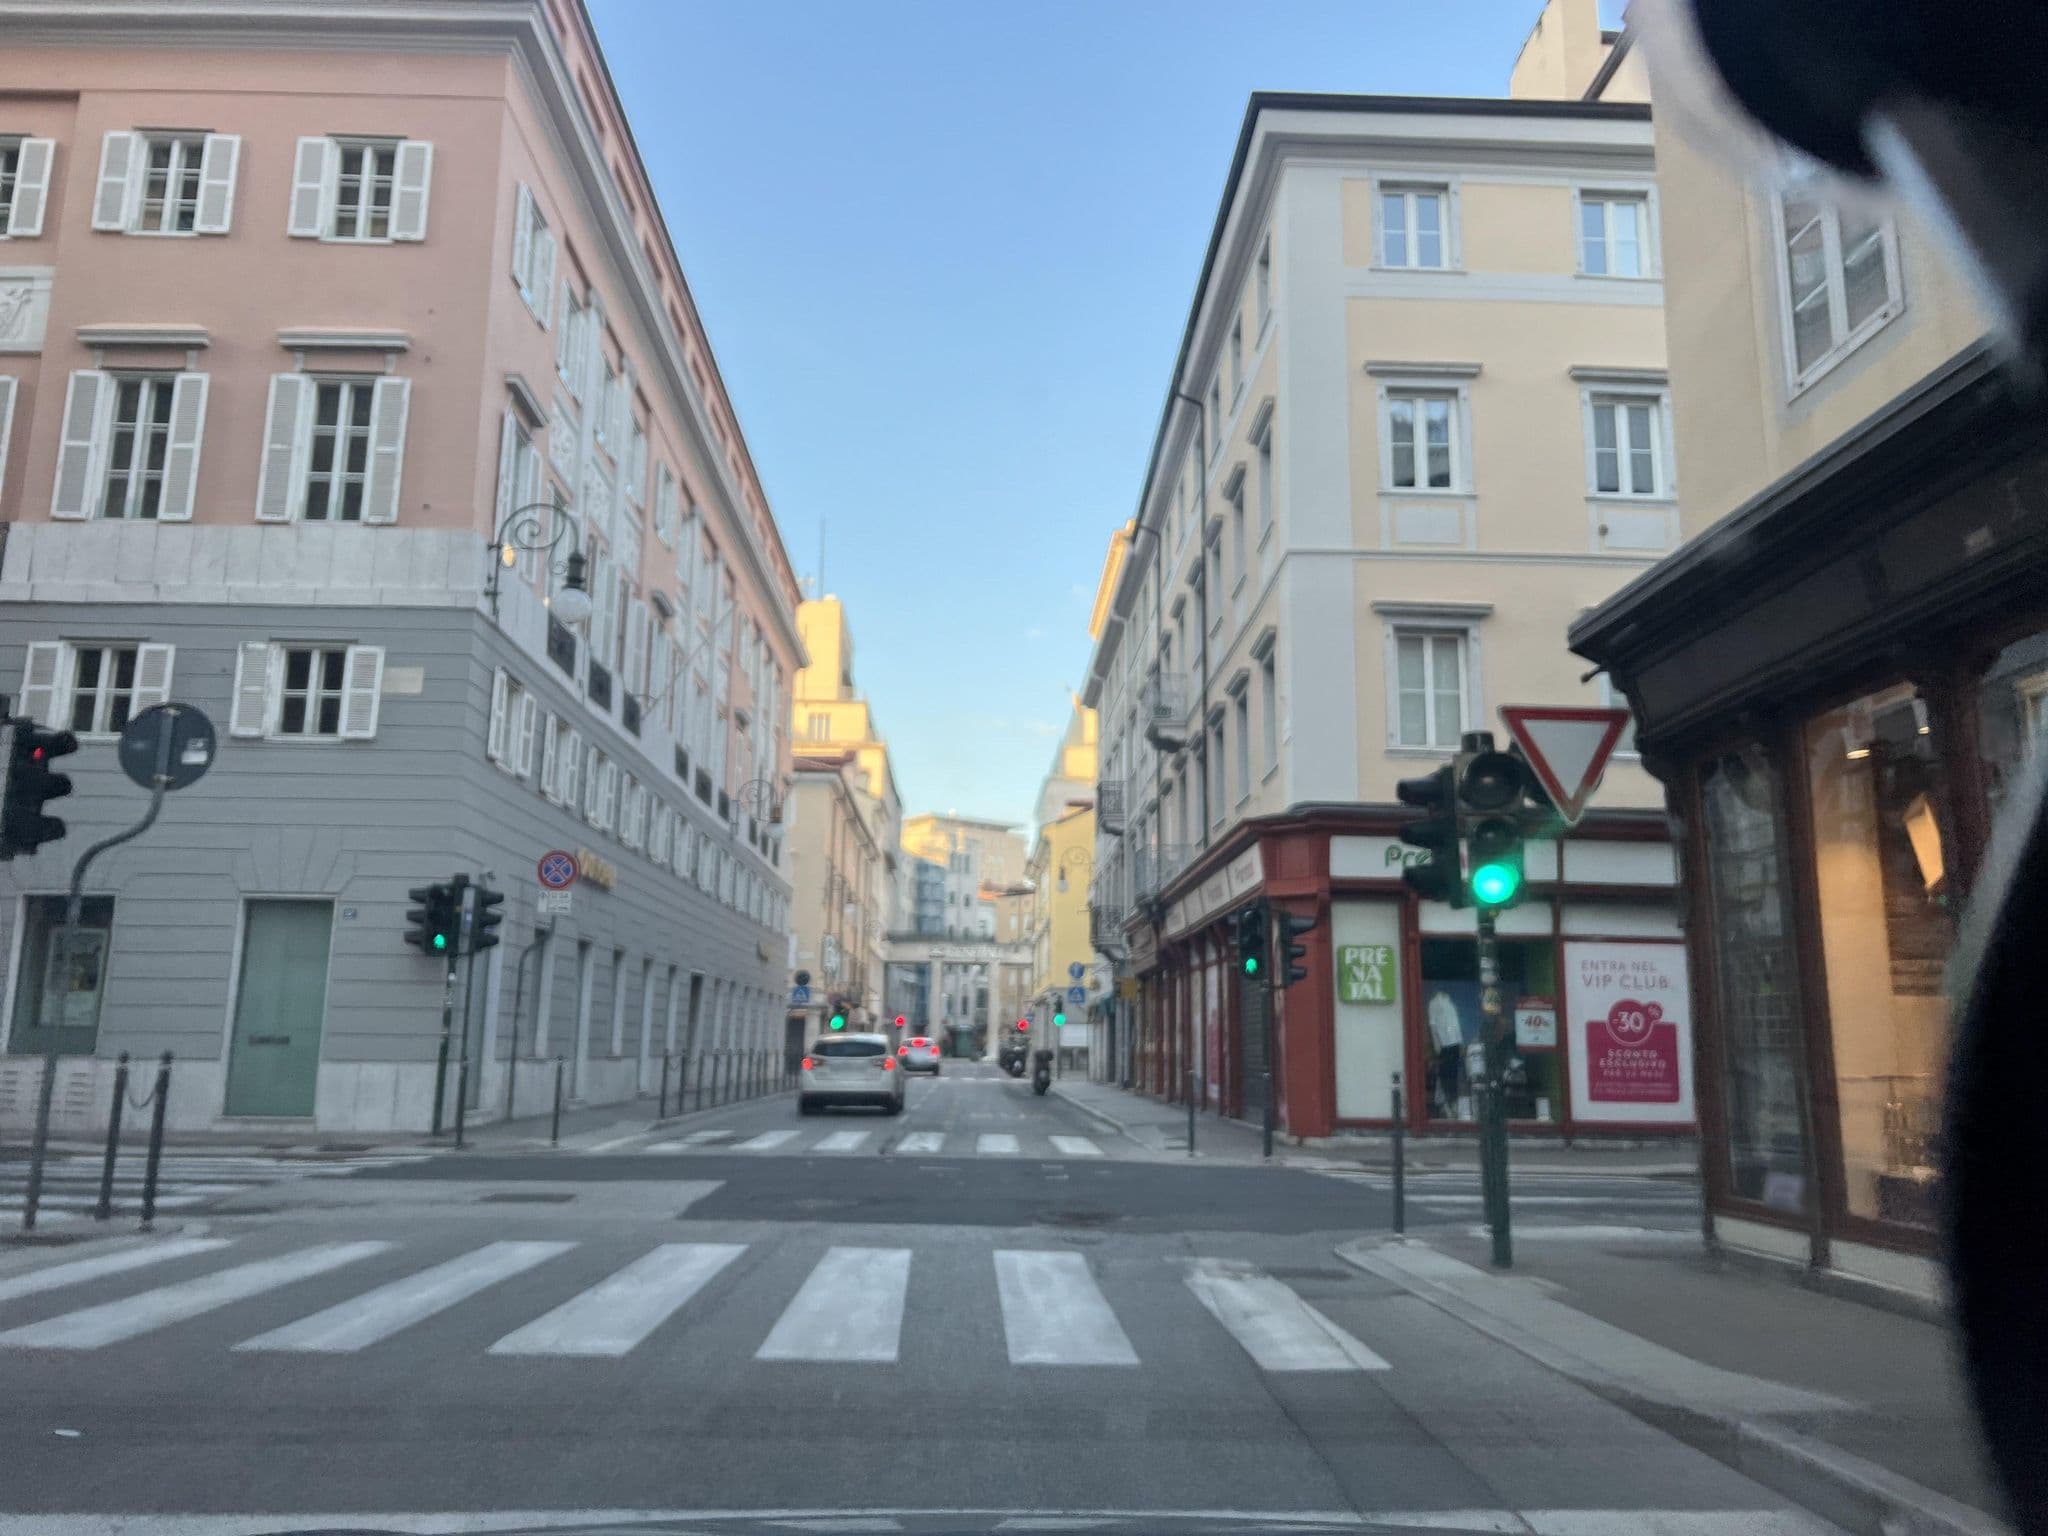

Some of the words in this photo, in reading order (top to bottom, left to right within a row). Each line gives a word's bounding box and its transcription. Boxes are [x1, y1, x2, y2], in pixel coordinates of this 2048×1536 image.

[1581, 960, 1626, 972] ENTRA
[1631, 961, 1657, 972] NEL
[1582, 973, 1612, 989] VIP
[1620, 974, 1669, 991] CLUB
